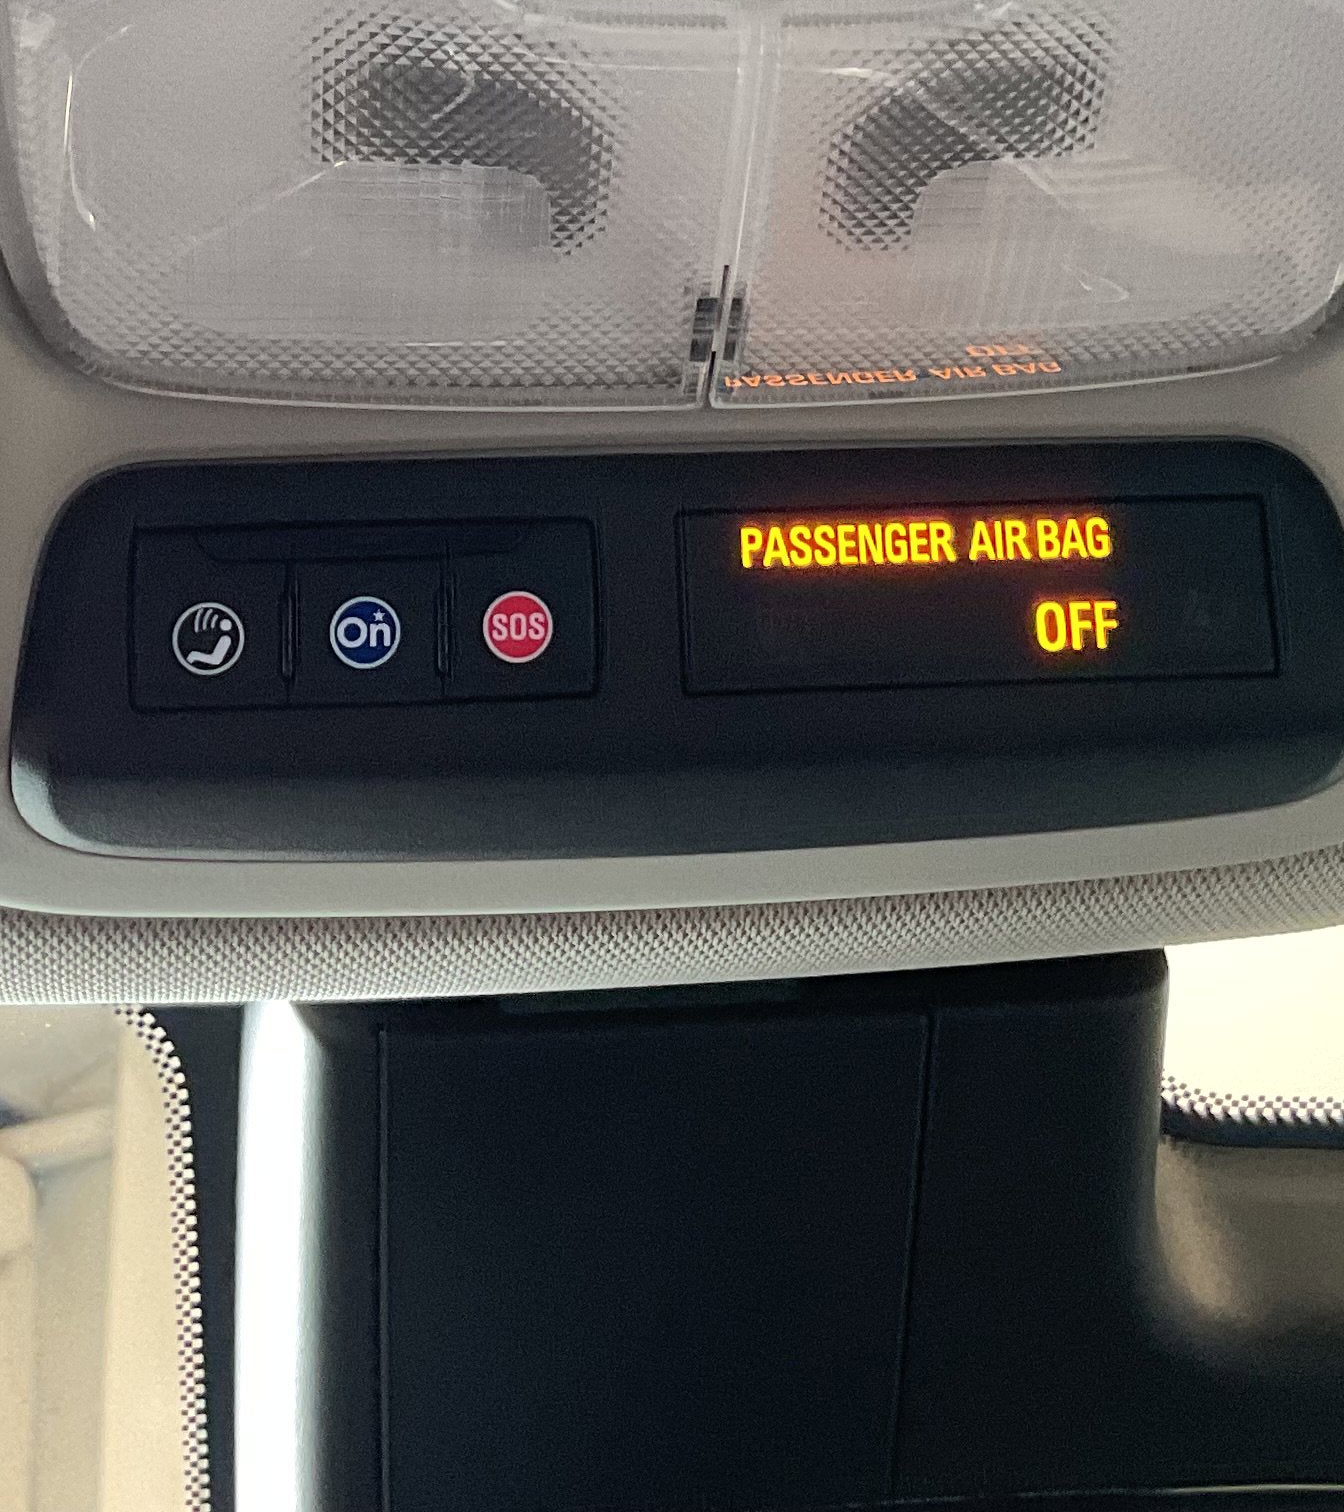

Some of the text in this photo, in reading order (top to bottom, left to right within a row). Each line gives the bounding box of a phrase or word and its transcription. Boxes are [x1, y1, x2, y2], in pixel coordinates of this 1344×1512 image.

[740, 517, 1111, 569] PASSENGER AIR BAG
[337, 617, 391, 648] On
[492, 613, 545, 641] SOS
[1035, 600, 1118, 653] OFF
